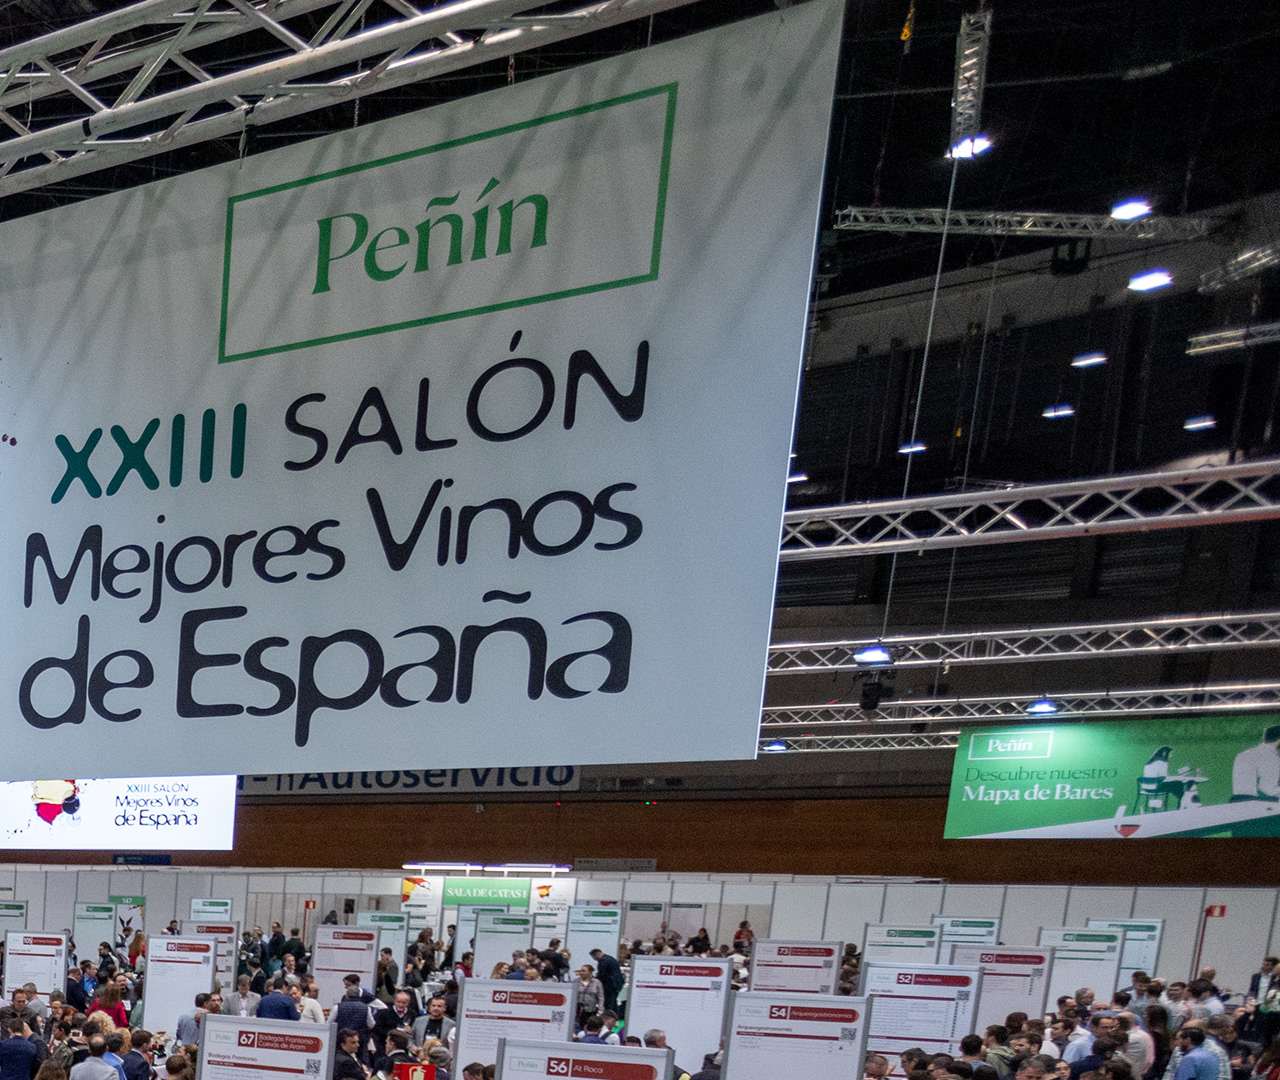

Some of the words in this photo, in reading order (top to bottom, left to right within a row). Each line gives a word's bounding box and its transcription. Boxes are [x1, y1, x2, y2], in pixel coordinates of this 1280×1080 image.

[312, 177, 548, 295] Peñín
[51, 403, 247, 504] XXIII
[284, 330, 649, 471] SALÓN
[24, 515, 345, 623] Mejores
[366, 479, 643, 571] Vinos
[19, 614, 154, 729] de
[176, 589, 633, 747] España
[987, 738, 1033, 752] Peñín
[298, 765, 575, 791] Autoservicio
[964, 766, 1046, 781] Descubre
[1049, 768, 1118, 780] nuestro
[126, 784, 150, 792] XXIII
[153, 781, 189, 792] SALÓN
[962, 785, 1019, 805] Mapa
[1024, 784, 1050, 800] de
[1054, 784, 1114, 800] Bares
[115, 796, 163, 811] Mejores
[165, 795, 199, 807] Vinos
[114, 809, 136, 826] de
[139, 809, 197, 830] España
[447, 888, 473, 897] SALA
[473, 888, 488, 897] DE
[489, 889, 521, 898] CATAS
[899, 975, 911, 983] 52
[494, 992, 507, 1001] 69
[771, 1008, 786, 1017] 54
[240, 1033, 254, 1044] 67
[549, 1060, 567, 1073] 56
[583, 1066, 603, 1074] Roca
